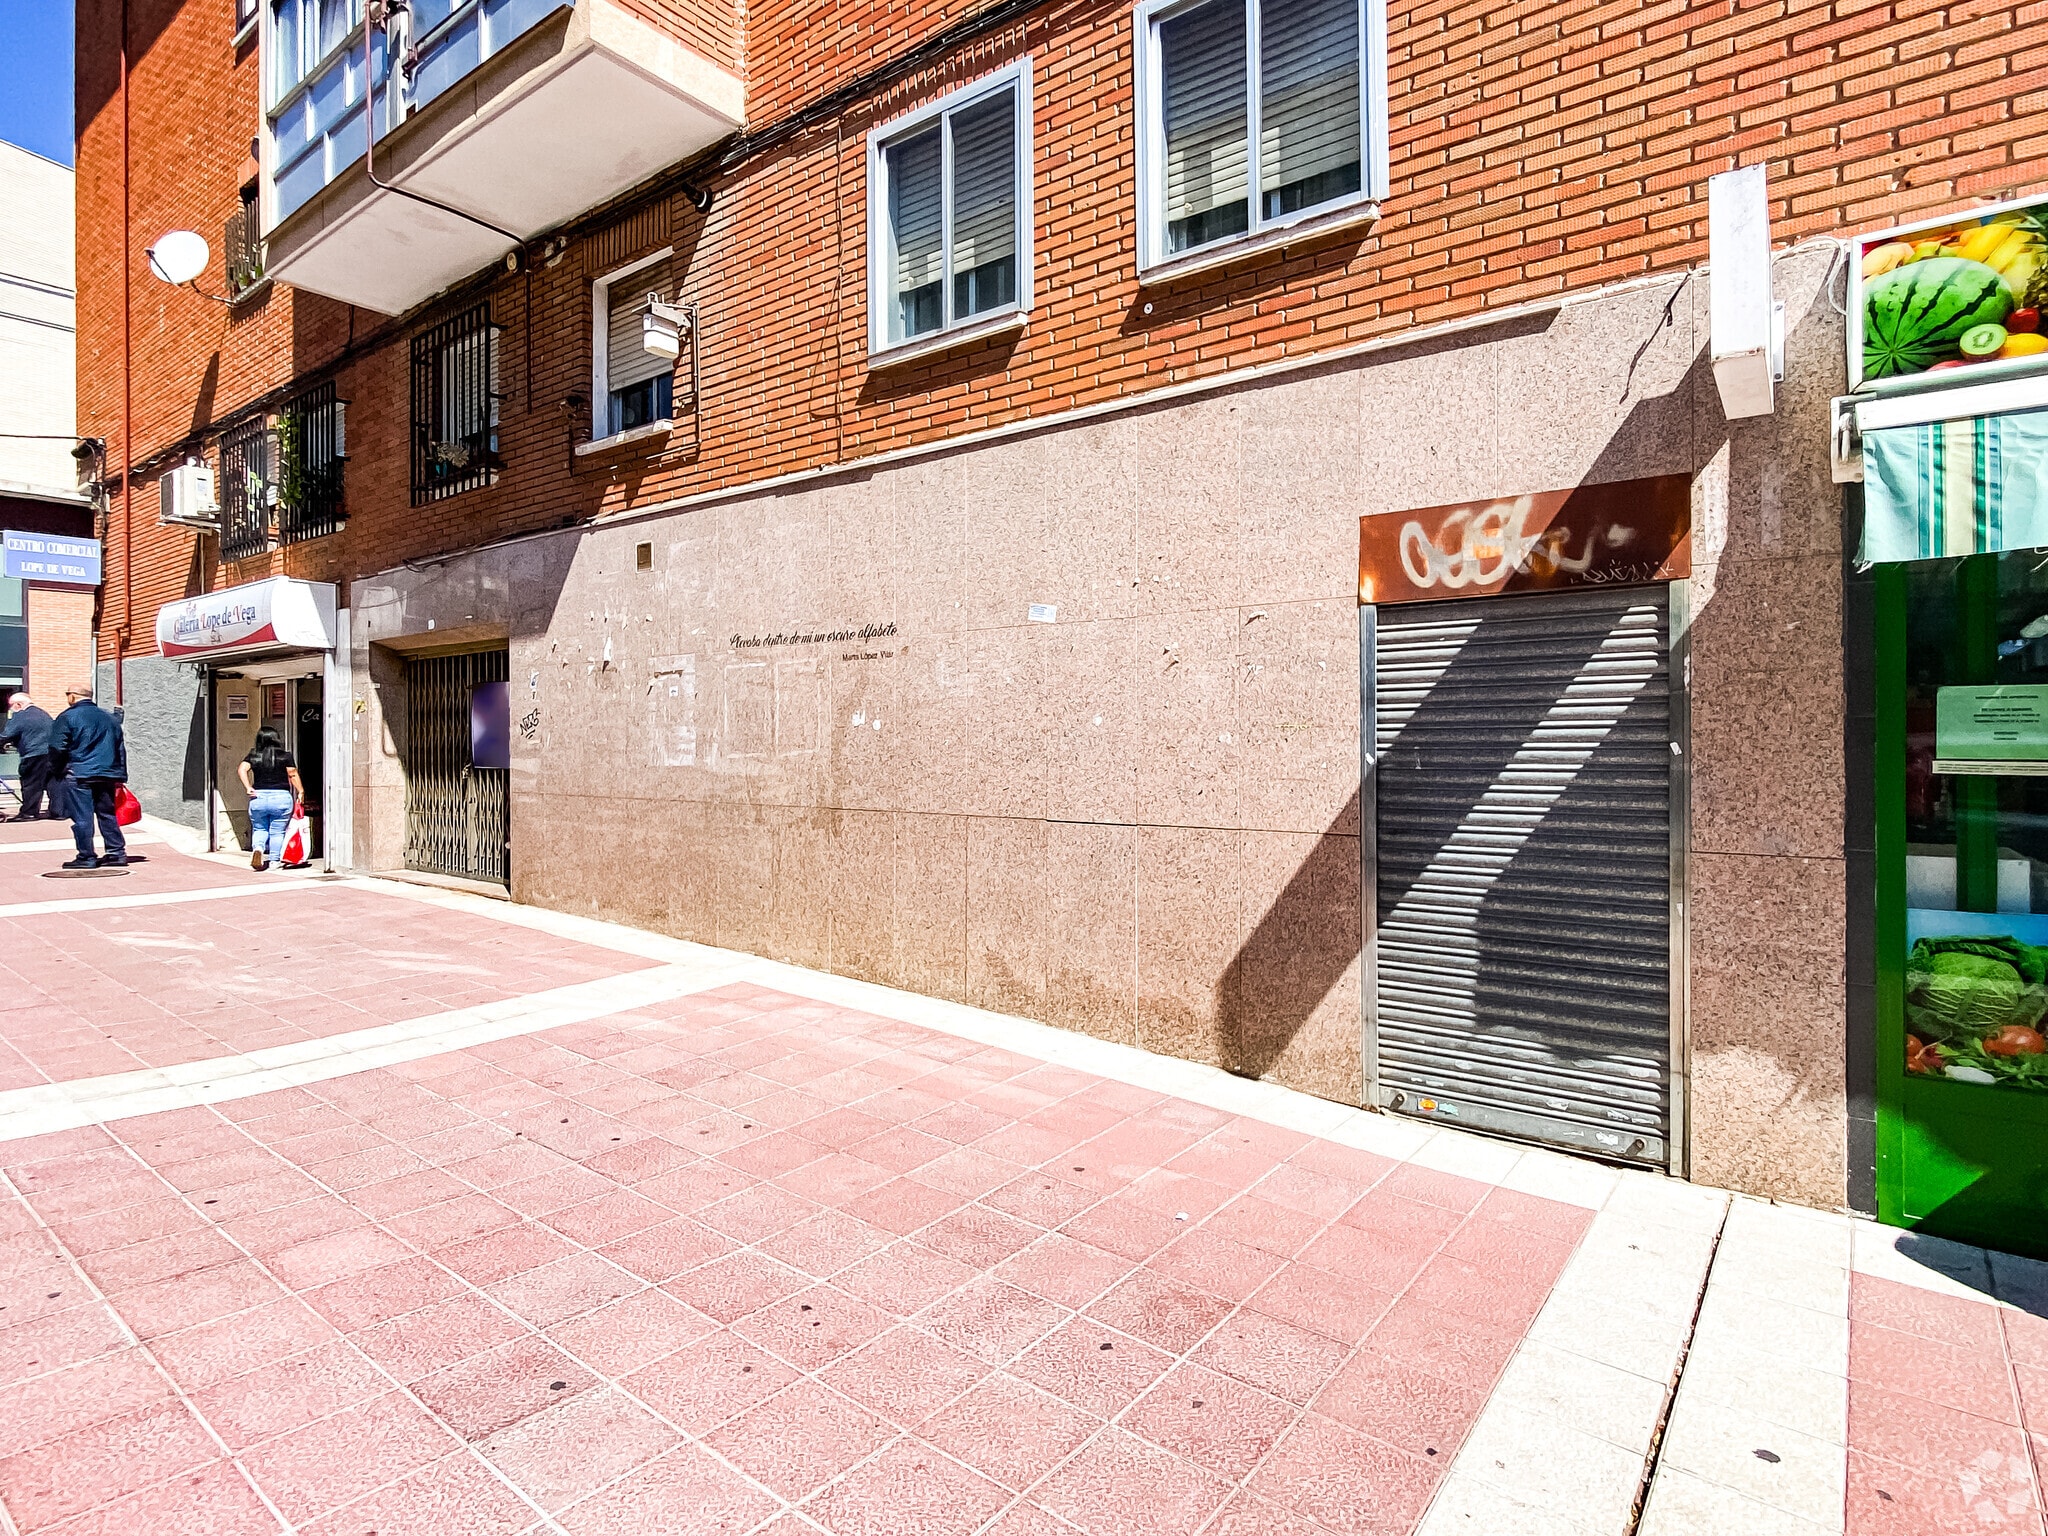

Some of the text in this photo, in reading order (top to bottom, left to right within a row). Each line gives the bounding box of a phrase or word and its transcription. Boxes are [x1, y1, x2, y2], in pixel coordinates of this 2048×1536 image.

[7, 538, 98, 558] CENTRO COMERCIAL
[21, 561, 86, 577] LOPE DE VEGA
[200, 613, 220, 632] Lope
[222, 606, 232, 624] de
[233, 604, 256, 625] Vega
